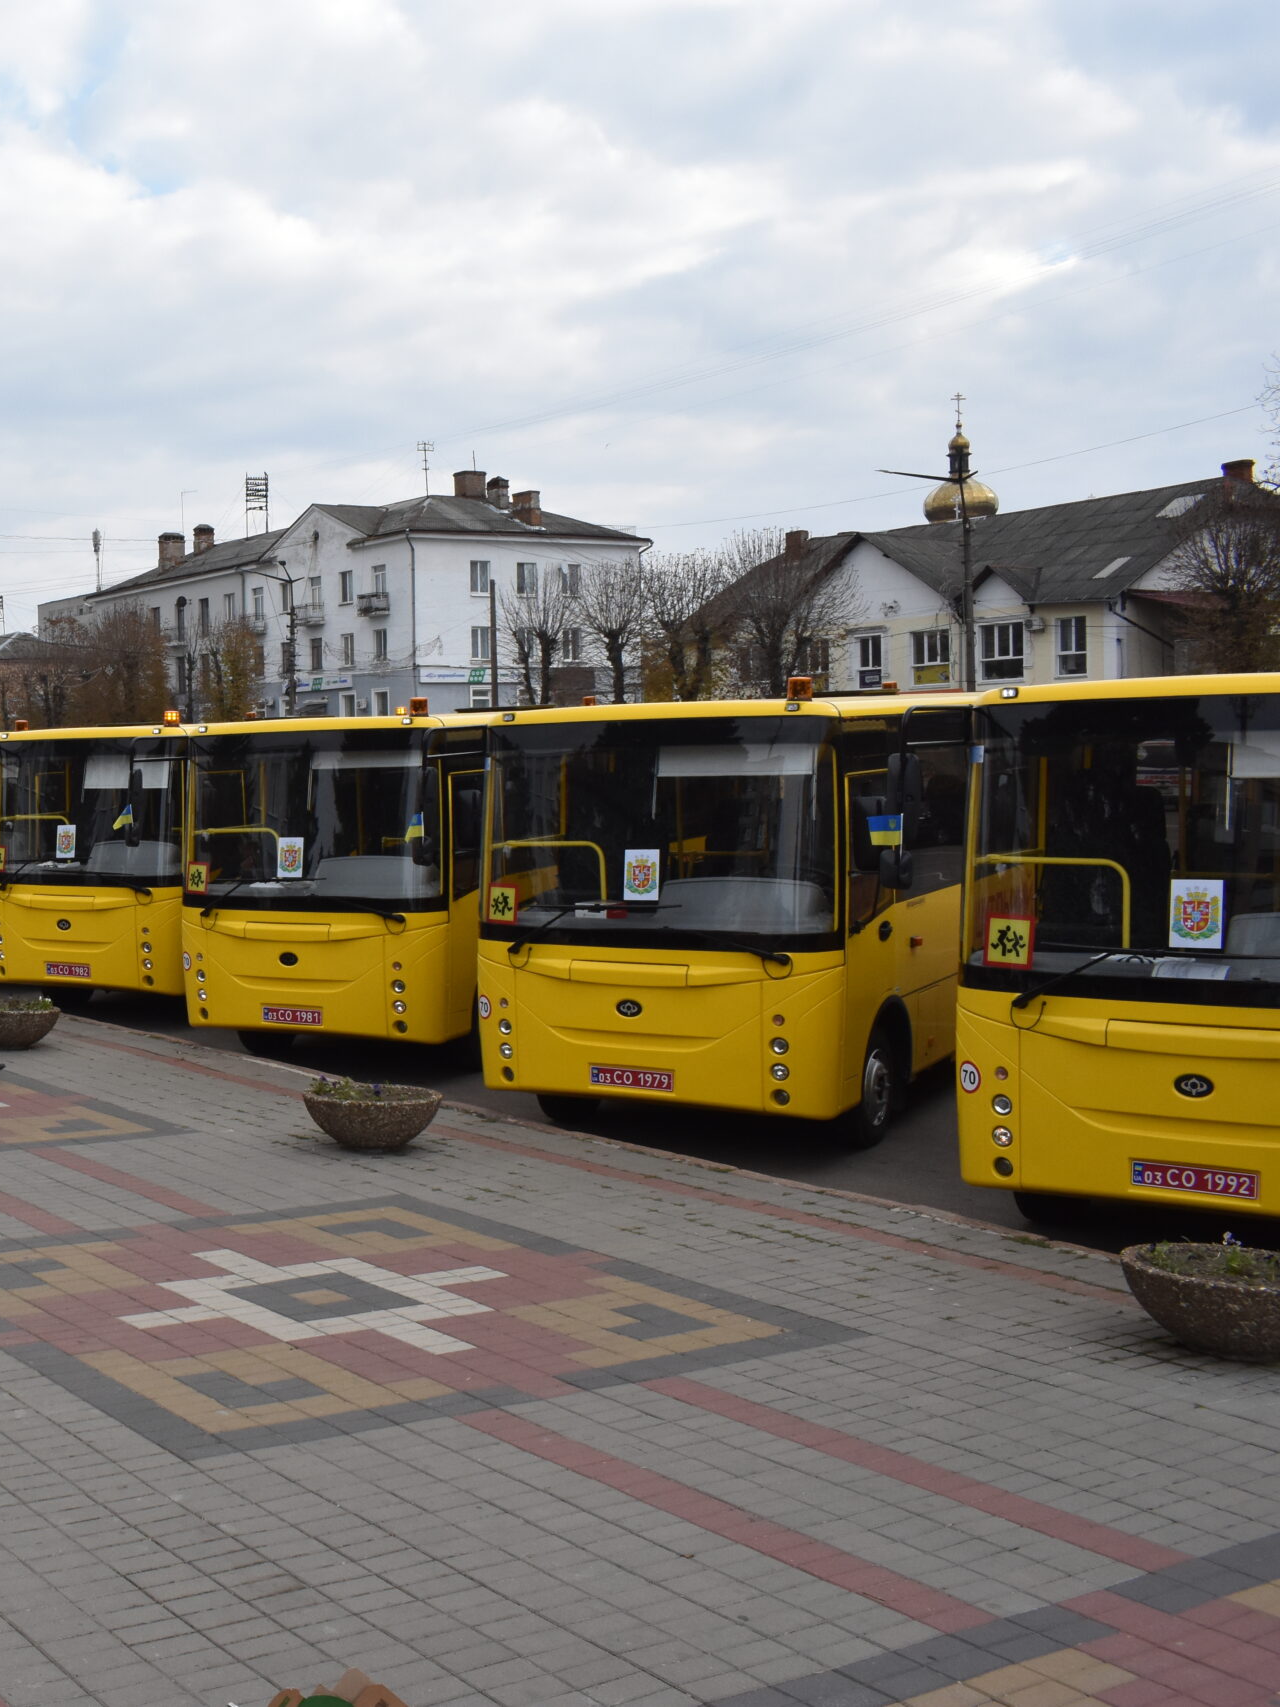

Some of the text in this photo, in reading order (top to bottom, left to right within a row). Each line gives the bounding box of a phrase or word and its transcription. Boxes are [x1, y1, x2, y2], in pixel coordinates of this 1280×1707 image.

[58, 965, 70, 975] CO
[71, 966, 89, 976] 1982
[268, 1010, 318, 1023] 03 CO 1981
[599, 1070, 669, 1088] 03 CO 1979
[962, 1069, 976, 1085] 70
[1144, 1171, 1162, 1184] 03
[1166, 1168, 1196, 1187] CO
[1203, 1173, 1250, 1195] 1992
